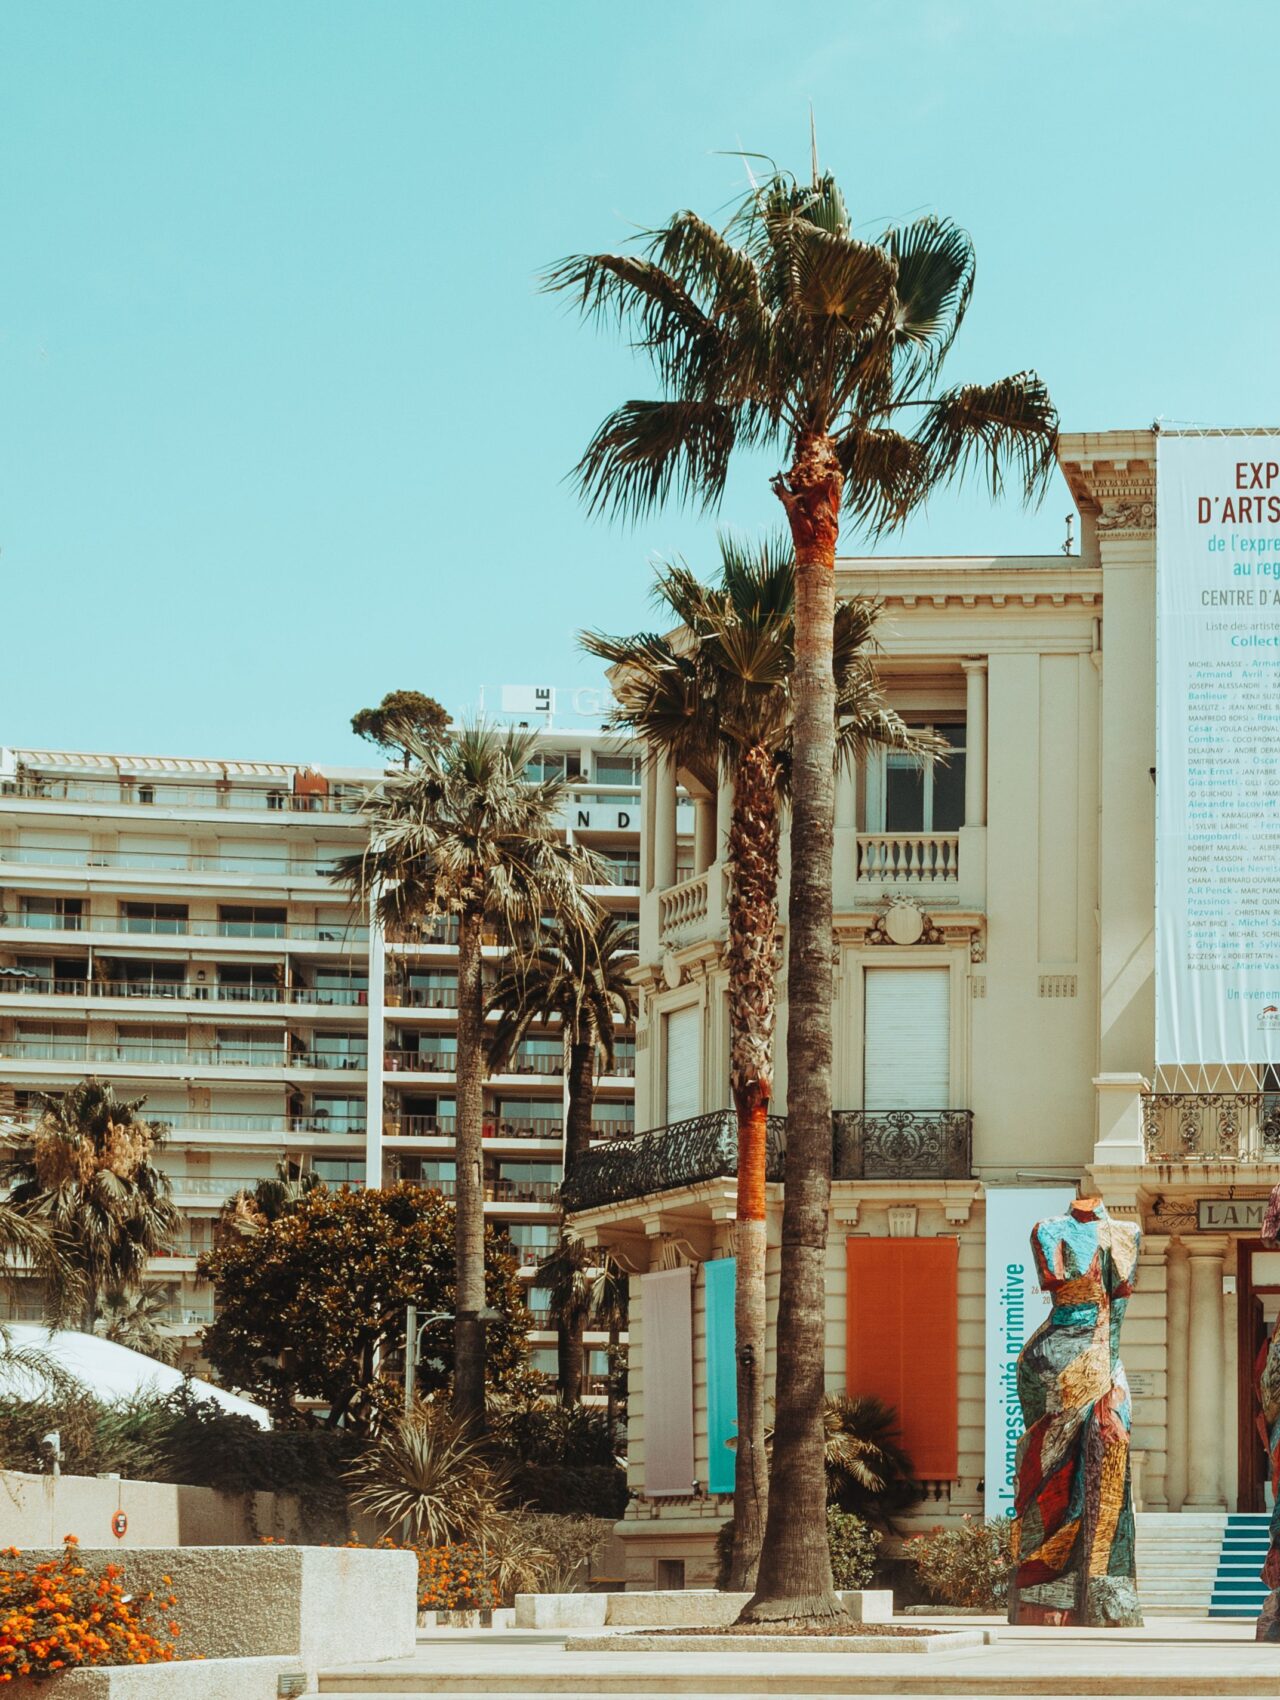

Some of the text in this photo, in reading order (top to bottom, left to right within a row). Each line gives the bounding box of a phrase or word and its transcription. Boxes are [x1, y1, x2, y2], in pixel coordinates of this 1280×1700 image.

[1198, 496, 1280, 524] D'ARTS
[1208, 534, 1226, 552] de
[1233, 562, 1250, 576] au
[1201, 590, 1254, 606] CENTRE
[1206, 622, 1228, 630] Liste
[1230, 622, 1248, 630] des
[536, 687, 600, 716] LE G
[1227, 988, 1240, 1000] Un
[1042, 1296, 1051, 1304] 20
